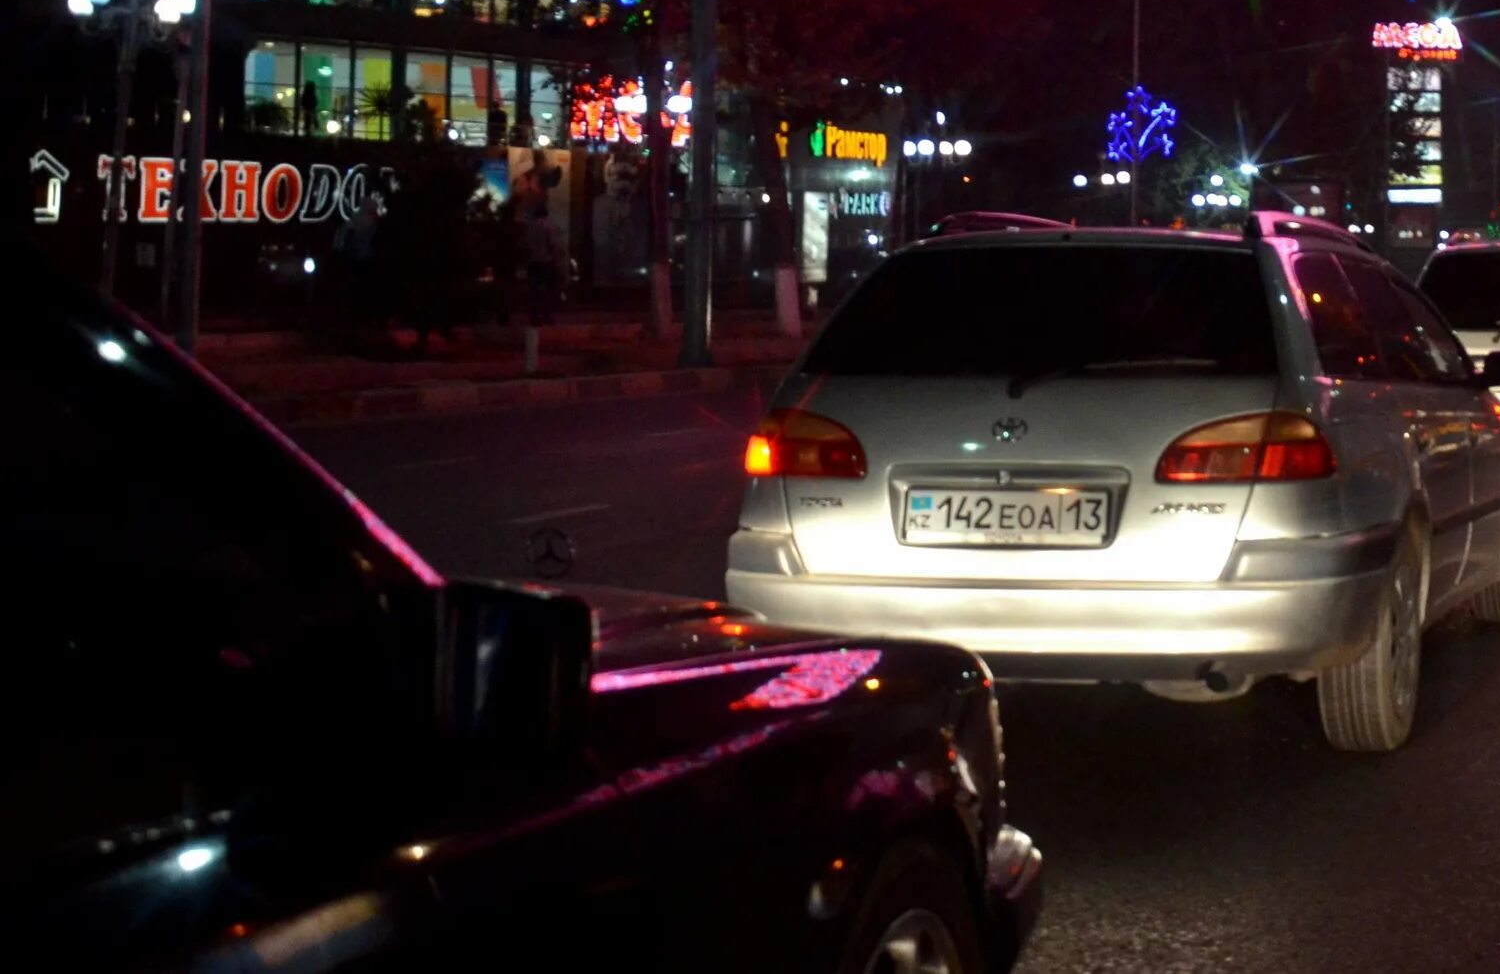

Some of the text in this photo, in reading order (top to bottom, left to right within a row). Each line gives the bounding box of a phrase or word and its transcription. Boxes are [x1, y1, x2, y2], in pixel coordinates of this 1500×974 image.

[909, 495, 1104, 531] KZ 142 EOA 13
